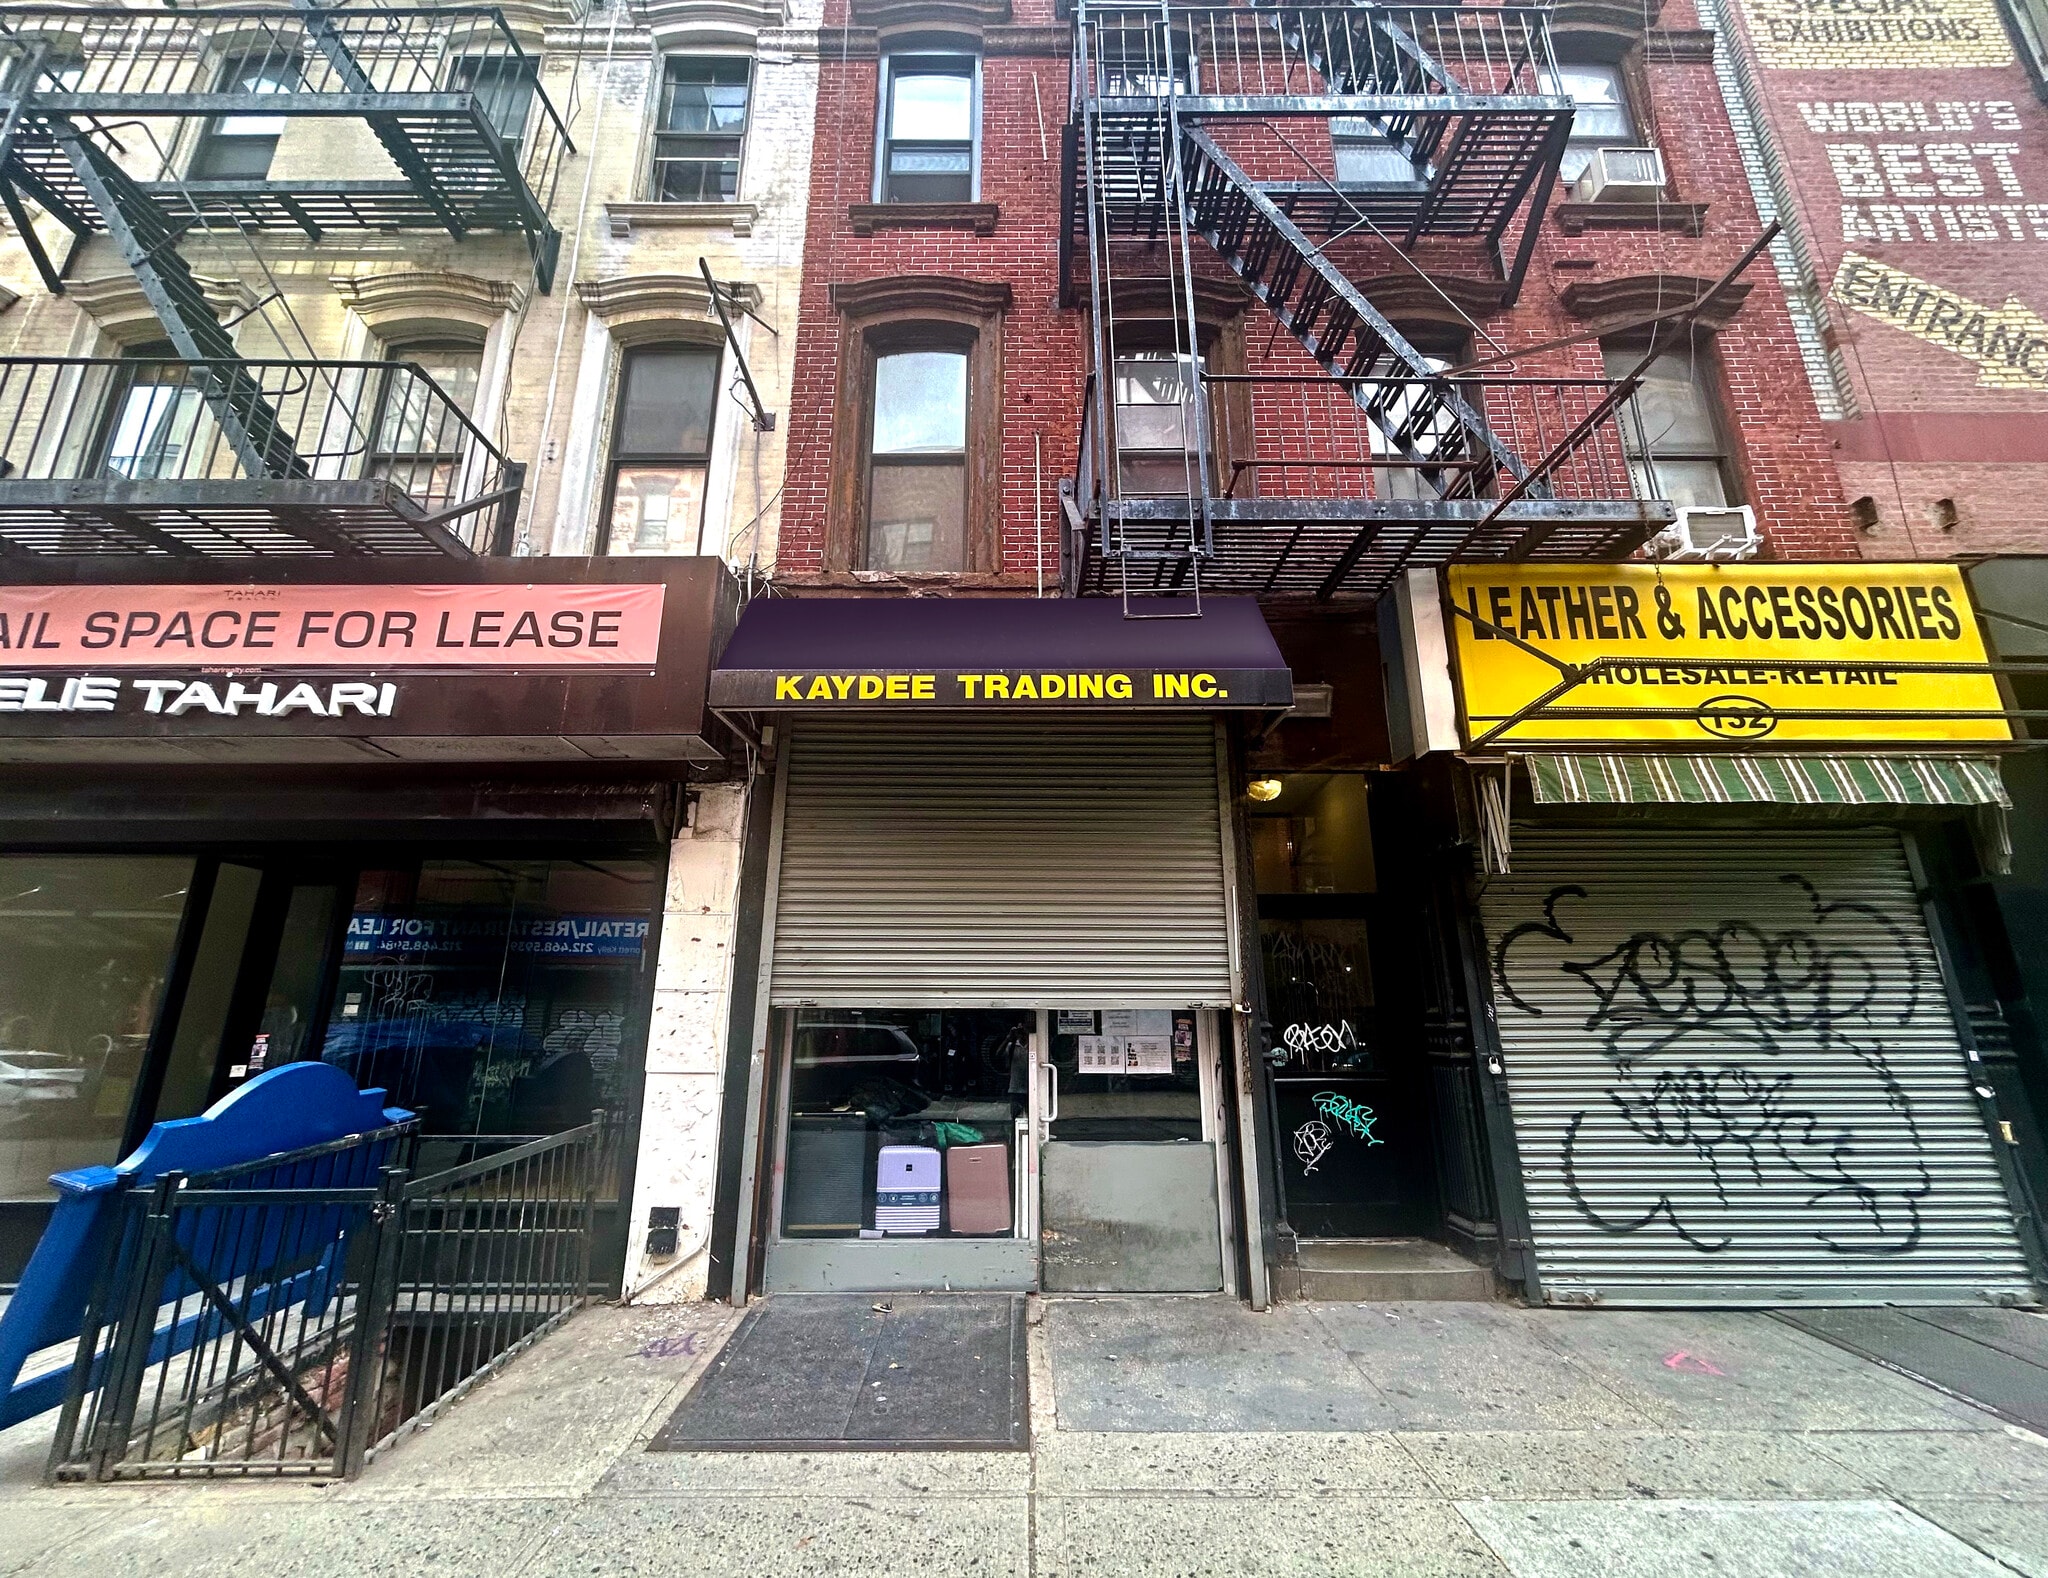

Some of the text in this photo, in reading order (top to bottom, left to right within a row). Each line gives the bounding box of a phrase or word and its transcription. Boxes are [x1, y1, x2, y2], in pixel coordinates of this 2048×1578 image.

[1767, 18, 1981, 41] EXHIBITIONS
[1797, 101, 2023, 132] WORLD'S
[1824, 142, 2024, 197] BEST
[0, 610, 623, 649] IL SPACE FOR LEASE
[1467, 585, 1961, 640] LEATHER & ACCESSORIES
[132, 680, 398, 717] TAHARI
[775, 673, 1230, 701] KAYDEE TRADING INC.
[1711, 707, 1768, 729] 132
